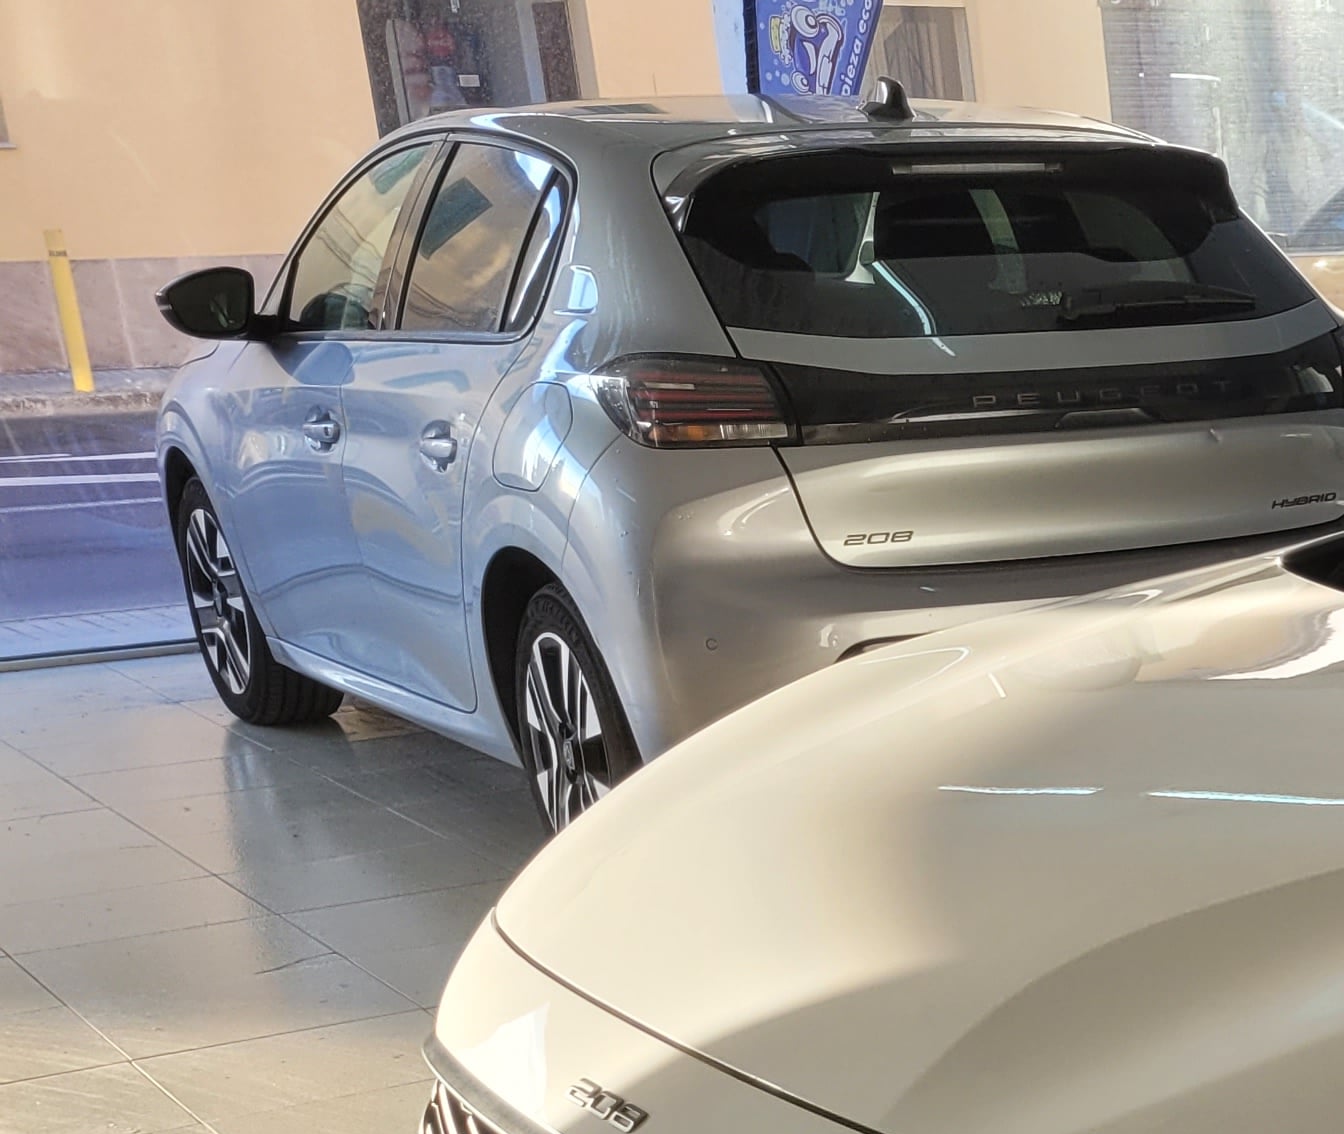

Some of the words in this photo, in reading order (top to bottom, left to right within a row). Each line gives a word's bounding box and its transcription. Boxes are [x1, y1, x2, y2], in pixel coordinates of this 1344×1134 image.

[972, 380, 1232, 408] PEUGEOT
[1271, 492, 1337, 510] HYBRID
[843, 530, 914, 546] 208
[566, 1077, 650, 1134] 208
